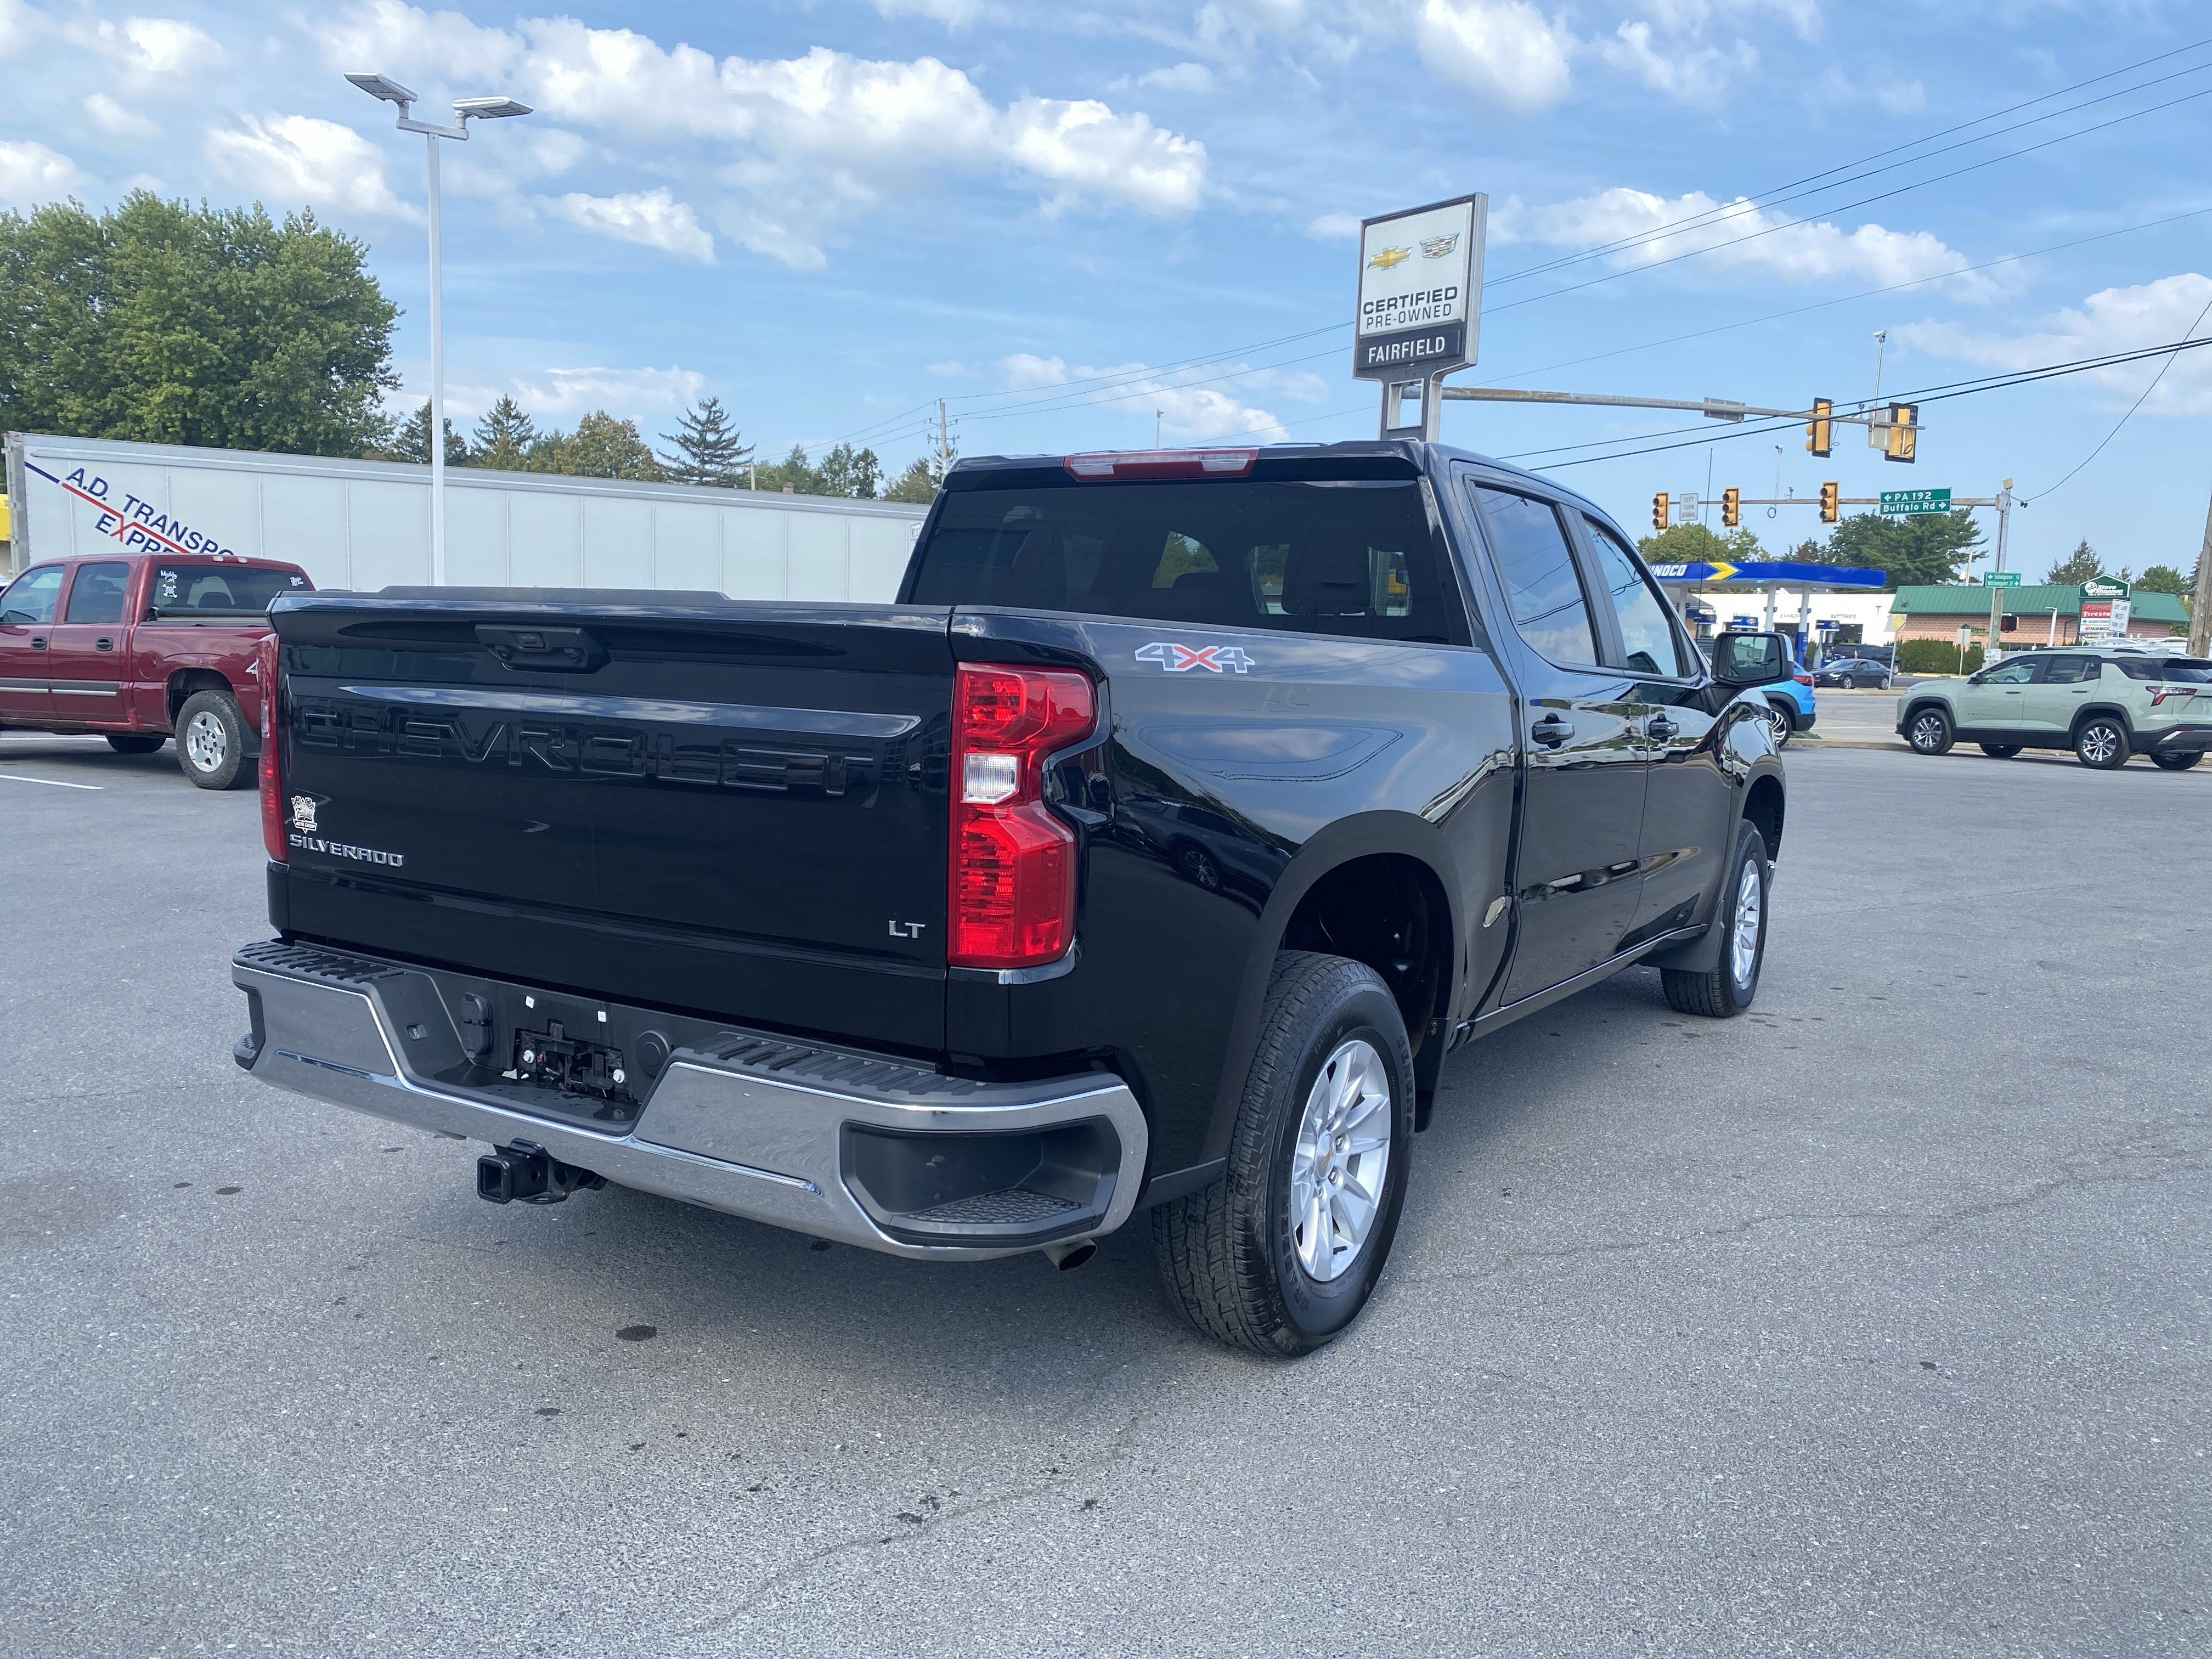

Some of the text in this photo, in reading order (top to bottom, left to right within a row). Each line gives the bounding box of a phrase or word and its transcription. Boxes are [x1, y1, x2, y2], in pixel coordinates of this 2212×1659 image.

[1363, 286, 1458, 315] CERTIFIED
[1367, 303, 1452, 329] PRE-OWNED
[1368, 336, 1445, 363] FAIRFIELD
[66, 467, 107, 501] A.D.
[1894, 492, 1932, 501] PA 192
[1883, 502, 1936, 512] Buffalo Rd
[300, 706, 876, 795] CHEVROLET
[290, 834, 404, 867] SILVERADO
[889, 920, 926, 939] LT
